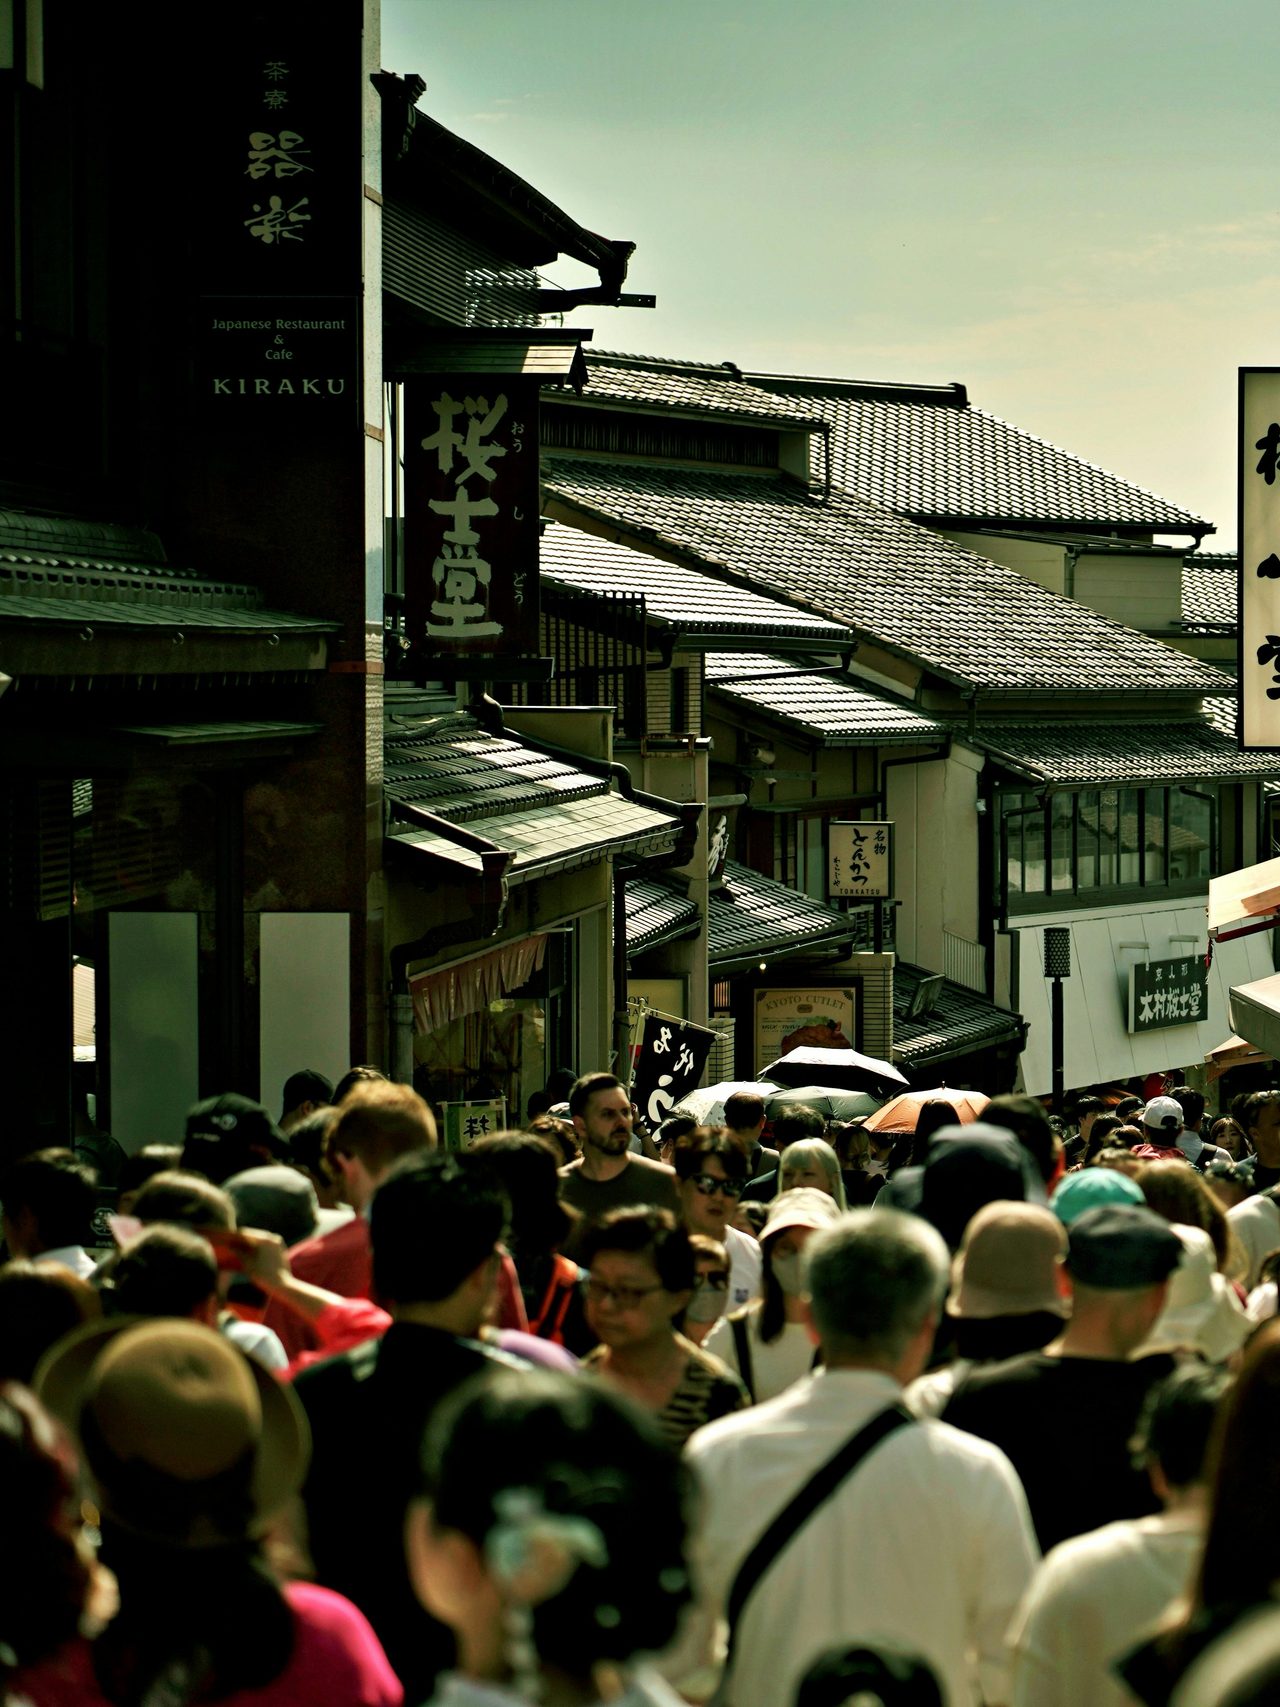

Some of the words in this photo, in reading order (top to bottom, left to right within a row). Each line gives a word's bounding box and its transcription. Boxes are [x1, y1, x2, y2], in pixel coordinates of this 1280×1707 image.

[262, 61, 290, 111] 茶寮
[211, 318, 272, 332] Japanese
[275, 318, 346, 330] Restaurant
[273, 334, 285, 345] &
[264, 348, 294, 360] Cafe
[212, 378, 346, 395] KIRAKU
[420, 390, 510, 638] 桜士堂
[849, 828, 871, 886] とんかつ
[766, 994, 802, 1011] KYOTO
[806, 994, 846, 1011] CUTLET
